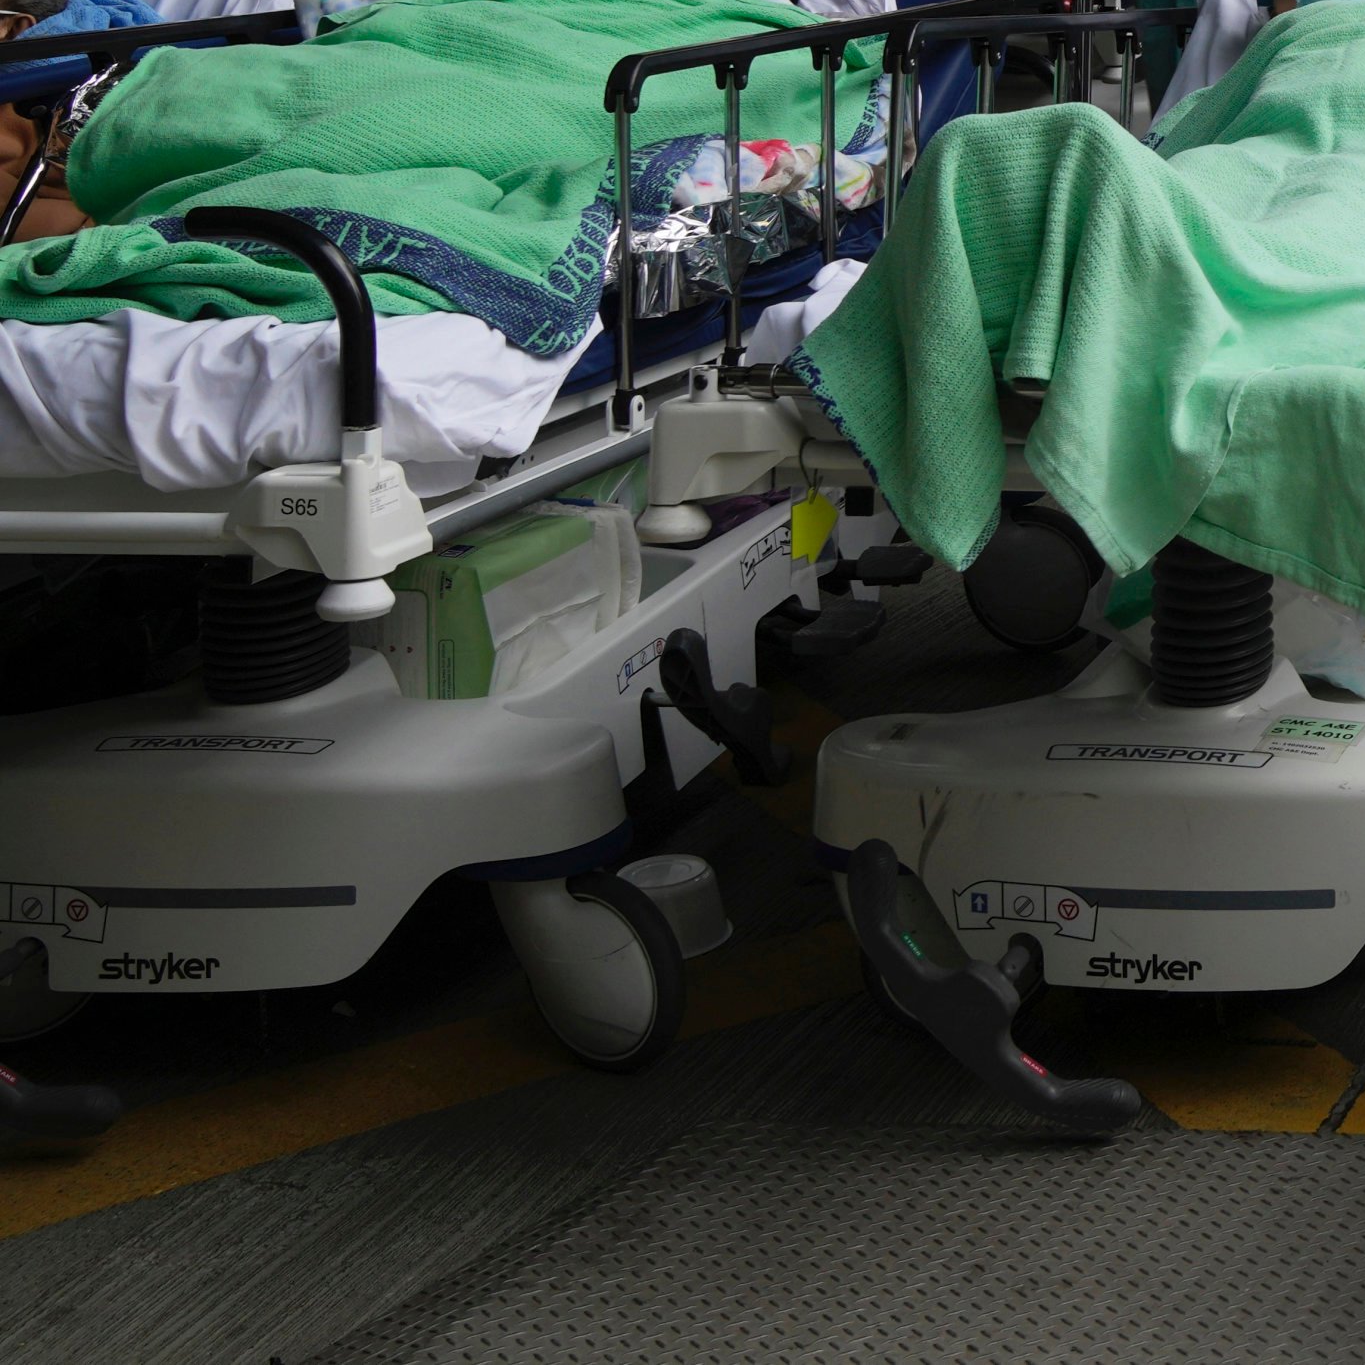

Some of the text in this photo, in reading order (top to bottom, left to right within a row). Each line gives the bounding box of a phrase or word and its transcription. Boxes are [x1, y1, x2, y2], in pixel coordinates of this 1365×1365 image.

[281, 498, 317, 516] S65
[1271, 727, 1354, 740] ST 14010
[1279, 718, 1358, 731] CMC A&E
[129, 737, 304, 751] TRANSPORT
[1077, 746, 1243, 764] TRANSPORT
[99, 952, 220, 984] stryker
[1086, 952, 1202, 984] stryker
